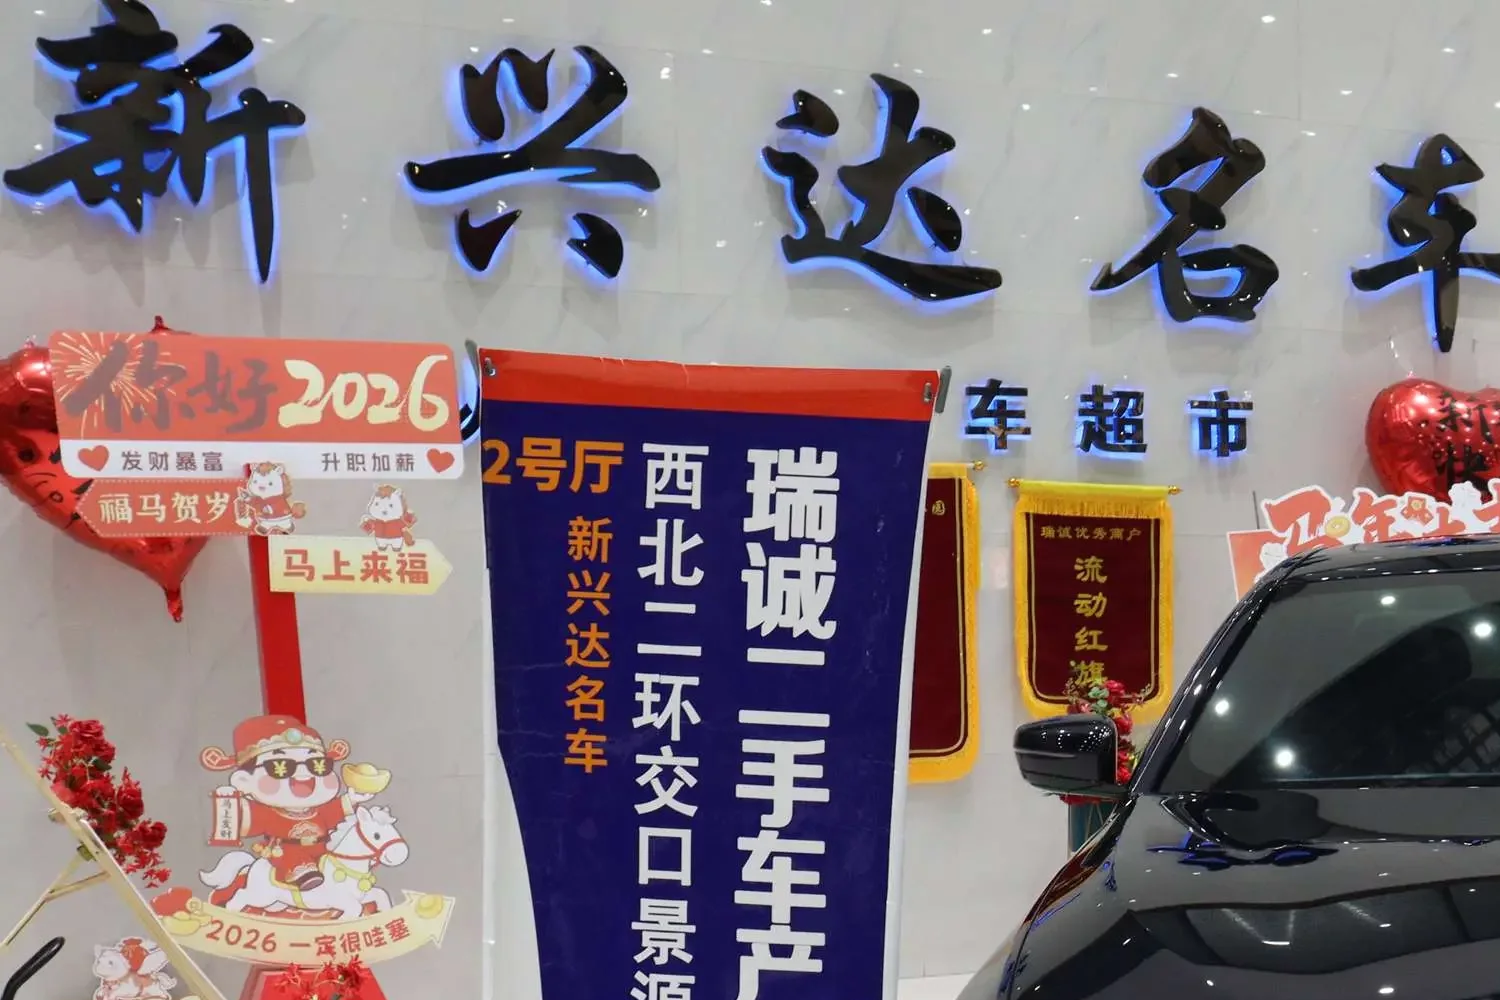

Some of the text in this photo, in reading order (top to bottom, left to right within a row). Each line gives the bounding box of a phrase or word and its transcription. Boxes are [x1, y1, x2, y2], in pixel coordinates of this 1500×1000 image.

[121, 450, 224, 473] 发财暴富
[321, 452, 416, 473] 升职加薪
[482, 437, 624, 494] 2号厅
[98, 491, 230, 524] 福马贺岁
[1040, 526, 1142, 541] 瑞诚优秀商户
[283, 549, 430, 584] 马上来福
[1074, 556, 1109, 686] 流动红旗
[564, 516, 613, 774] 新兴达名车
[206, 917, 410, 960] 2026 一定很哇塞
